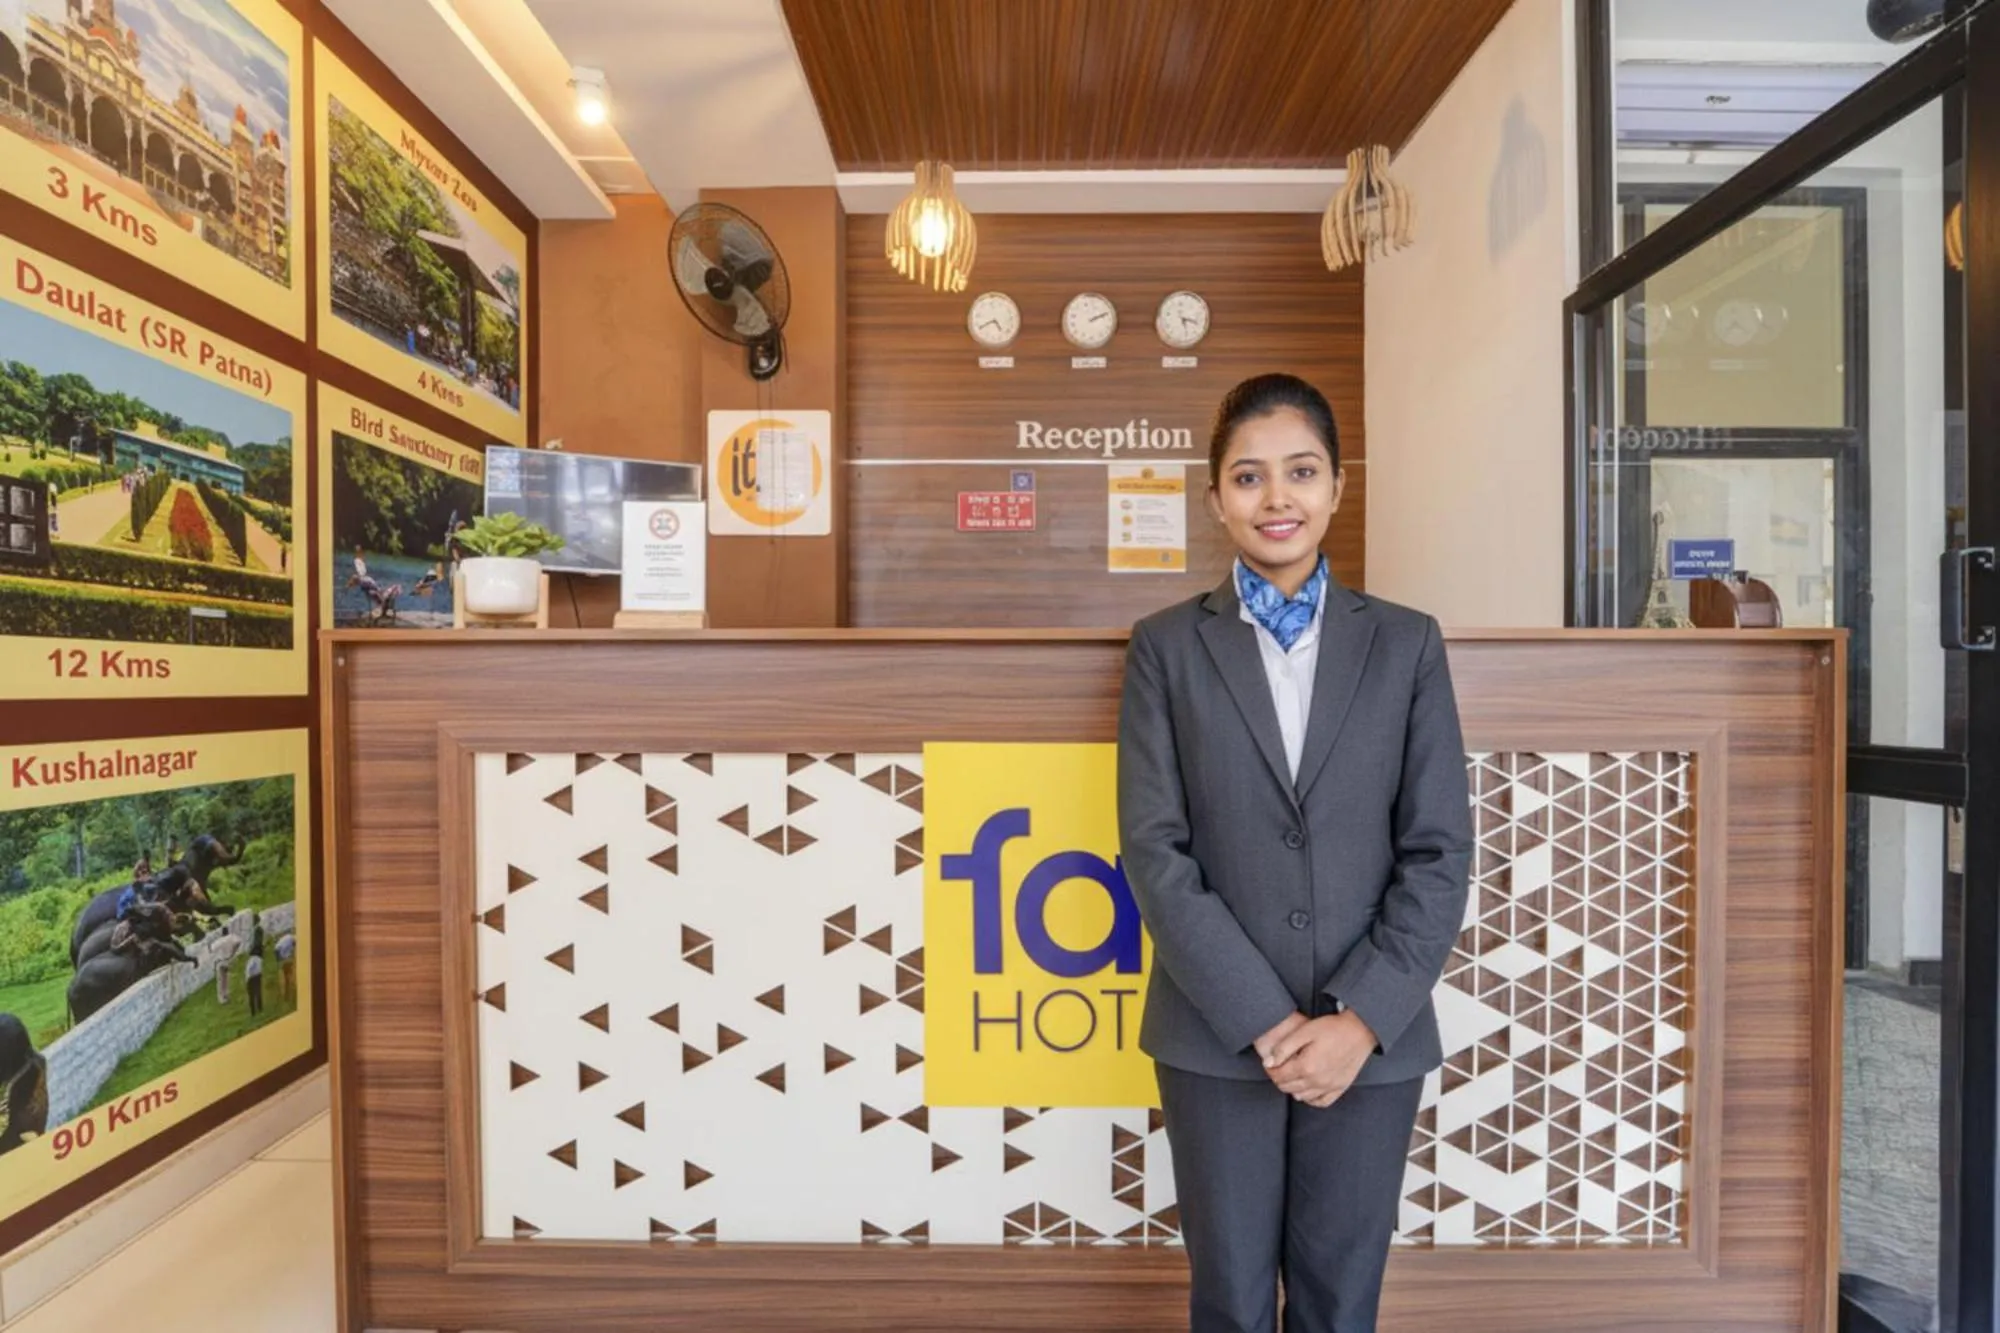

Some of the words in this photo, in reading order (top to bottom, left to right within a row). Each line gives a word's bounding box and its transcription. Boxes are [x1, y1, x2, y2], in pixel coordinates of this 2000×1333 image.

[47, 166, 69, 199] 3
[82, 183, 158, 246] Kms
[16, 257, 127, 333] Daulat
[139, 316, 189, 358] (SR
[199, 340, 273, 397] Patna)
[417, 370, 427, 389] 4
[350, 407, 383, 438] Bird
[1015, 417, 1194, 458] Reception
[732, 437, 761, 496] it
[47, 647, 88, 677] 12
[101, 649, 171, 679] Kms
[12, 749, 198, 788] Kushalnagar
[52, 1117, 95, 1161] 90
[107, 1081, 179, 1132] Kms
